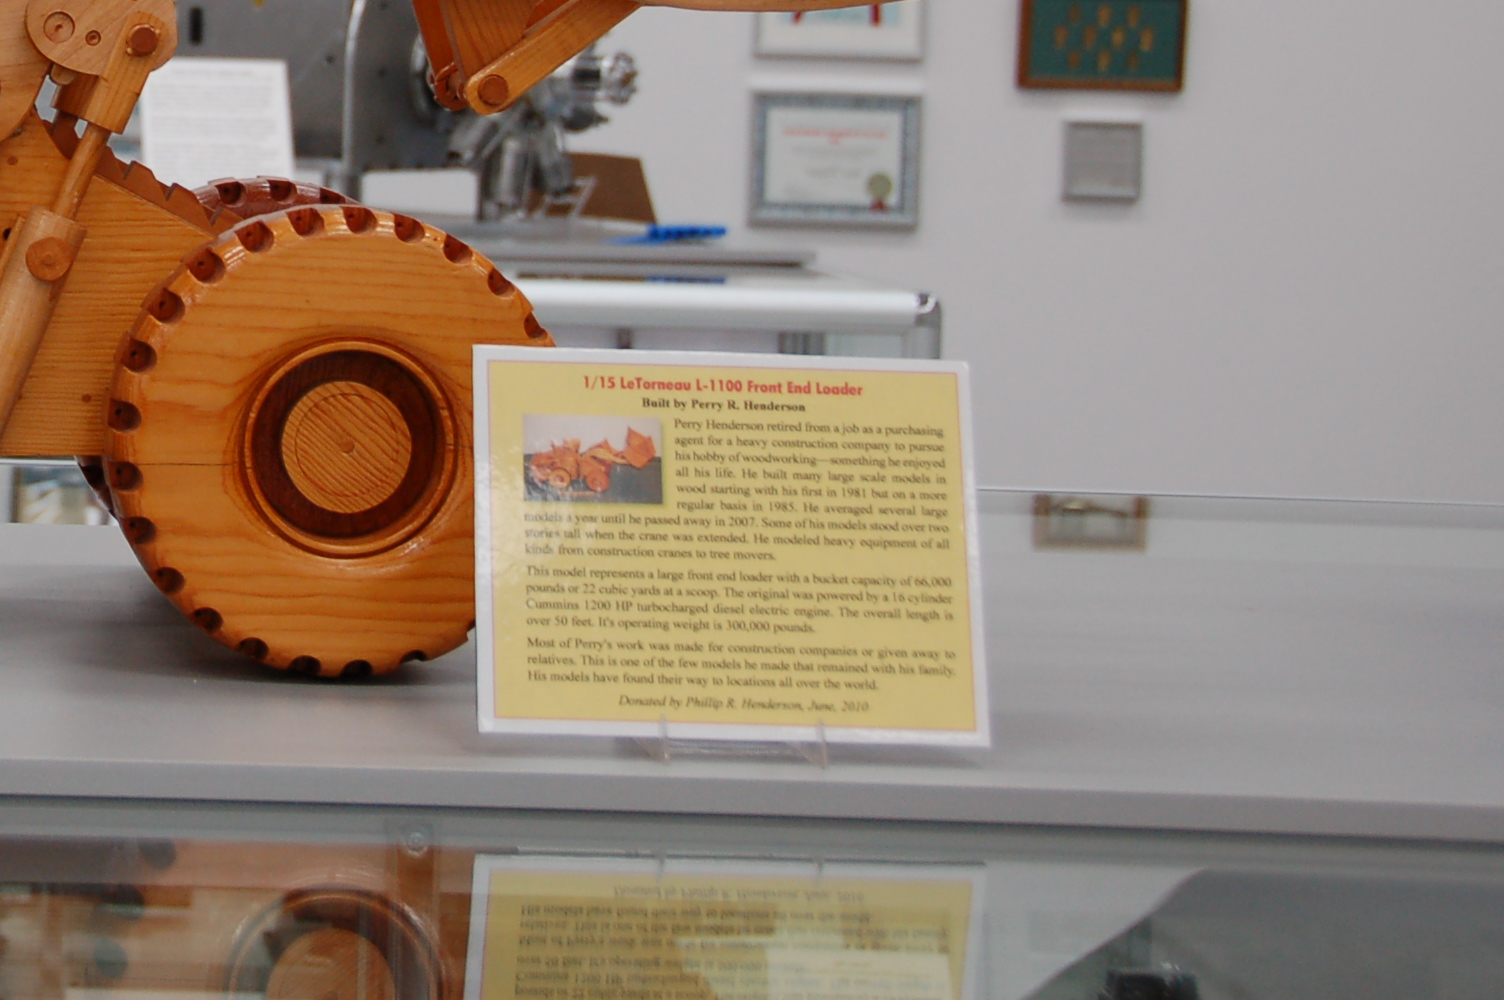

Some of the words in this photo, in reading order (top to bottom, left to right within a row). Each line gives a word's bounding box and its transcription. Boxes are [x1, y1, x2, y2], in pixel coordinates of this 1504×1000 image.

[582, 374, 616, 390] 1/15
[619, 376, 690, 391] LeTorneau
[695, 378, 743, 393] L-1100
[746, 381, 782, 393] Front
[785, 381, 812, 394] End
[815, 381, 863, 395] Loader
[641, 396, 670, 408] Built
[672, 397, 688, 411] by
[690, 398, 724, 412] Perry
[726, 399, 740, 410] R.
[742, 399, 806, 412] Henderson
[673, 418, 703, 431] Perry
[705, 418, 764, 431] Henderson
[766, 420, 802, 432] retired
[804, 421, 831, 433] from
[841, 422, 860, 436] job
[884, 423, 944, 438] purchasing
[674, 435, 704, 448] agent
[706, 434, 723, 446] for
[735, 435, 769, 449] heavy
[771, 436, 838, 449] construction
[841, 441, 891, 453] company
[908, 443, 945, 454] pursue
[673, 449, 690, 461] his
[692, 450, 727, 464] hobby
[902, 456, 946, 471] enjoyed
[675, 466, 689, 477] all
[693, 466, 710, 477] his
[762, 468, 788, 480] built
[792, 472, 823, 483] many
[827, 470, 854, 484] large
[859, 471, 887, 482] scale
[891, 472, 930, 484] models
[675, 482, 706, 493] wood
[709, 483, 751, 497] starting
[753, 484, 778, 495] with
[781, 485, 798, 496] his
[800, 485, 823, 497] first
[840, 487, 867, 498] 1981
[870, 487, 889, 499] but
[918, 492, 947, 500] more
[676, 498, 715, 512] regular
[719, 499, 747, 511] basis
[751, 500, 763, 511] in
[823, 502, 873, 517] averaged
[877, 504, 916, 516] several
[920, 505, 948, 519] large
[600, 512, 626, 524] until
[644, 513, 681, 528] passed
[683, 517, 712, 528] away
[761, 517, 792, 528] Some
[808, 518, 825, 529] his
[827, 518, 867, 530] models
[869, 520, 899, 531] stood
[901, 523, 926, 532] over
[927, 523, 949, 532] two
[584, 528, 615, 540] when
[617, 529, 635, 540] the
[638, 532, 668, 541] crane
[671, 533, 693, 542] was
[772, 533, 820, 545] modeled
[823, 535, 856, 549] heavy
[859, 536, 917, 551] equipment
[935, 538, 950, 549] all
[587, 544, 654, 557] construction
[657, 549, 692, 558] cranes
[708, 549, 730, 559] tree
[524, 564, 549, 576] This
[552, 565, 587, 577] model
[589, 568, 645, 581] represents
[656, 568, 684, 582] large
[686, 569, 714, 581] front
[716, 570, 736, 581] end
[738, 570, 774, 582] loader
[775, 571, 801, 583] with
[811, 572, 849, 584] bucket
[851, 574, 897, 588] capacity
[525, 581, 565, 596] pounds
[598, 583, 629, 595] cubic
[630, 584, 661, 598] yards
[722, 586, 744, 598] The
[746, 587, 790, 602] original
[791, 591, 813, 600] was
[815, 589, 864, 604] powered
[907, 592, 953, 606] cylinder
[525, 598, 579, 610] Cummins
[583, 599, 611, 611] 1200
[636, 600, 709, 616] turbocharged
[712, 602, 745, 614] diesel
[749, 604, 789, 616] electric
[837, 606, 859, 617] The
[863, 607, 901, 619] overall
[905, 608, 940, 623] length
[526, 617, 551, 625] over
[597, 616, 614, 627] It's
[617, 616, 669, 631] operating
[672, 618, 710, 632] weight
[526, 637, 555, 648] Most
[574, 638, 612, 652] Perry's
[615, 638, 645, 650] work
[648, 642, 670, 651] was
[673, 640, 703, 652] made
[707, 641, 724, 652] for
[727, 642, 795, 654] construction
[799, 644, 857, 659] companies
[877, 646, 908, 660] given
[911, 650, 941, 661] away
[579, 654, 604, 666] This
[620, 658, 640, 667] one
[657, 656, 674, 668] the
[677, 656, 699, 668] few
[701, 657, 741, 669] models
[760, 659, 790, 671] made
[792, 660, 814, 671] that
[816, 661, 868, 673] remained
[870, 662, 896, 674] with
[898, 663, 915, 674] his
[527, 669, 547, 681] His
[549, 670, 589, 682] models
[592, 671, 619, 683] have
[622, 672, 655, 684] found
[656, 673, 683, 685] their
[685, 676, 709, 688] way
[725, 674, 775, 687] locations
[778, 676, 793, 688] all
[795, 679, 821, 688] over
[822, 677, 840, 689] the
[617, 694, 666, 707] Donated
[684, 696, 723, 711] Phillip
[840, 700, 869, 712] 2010
